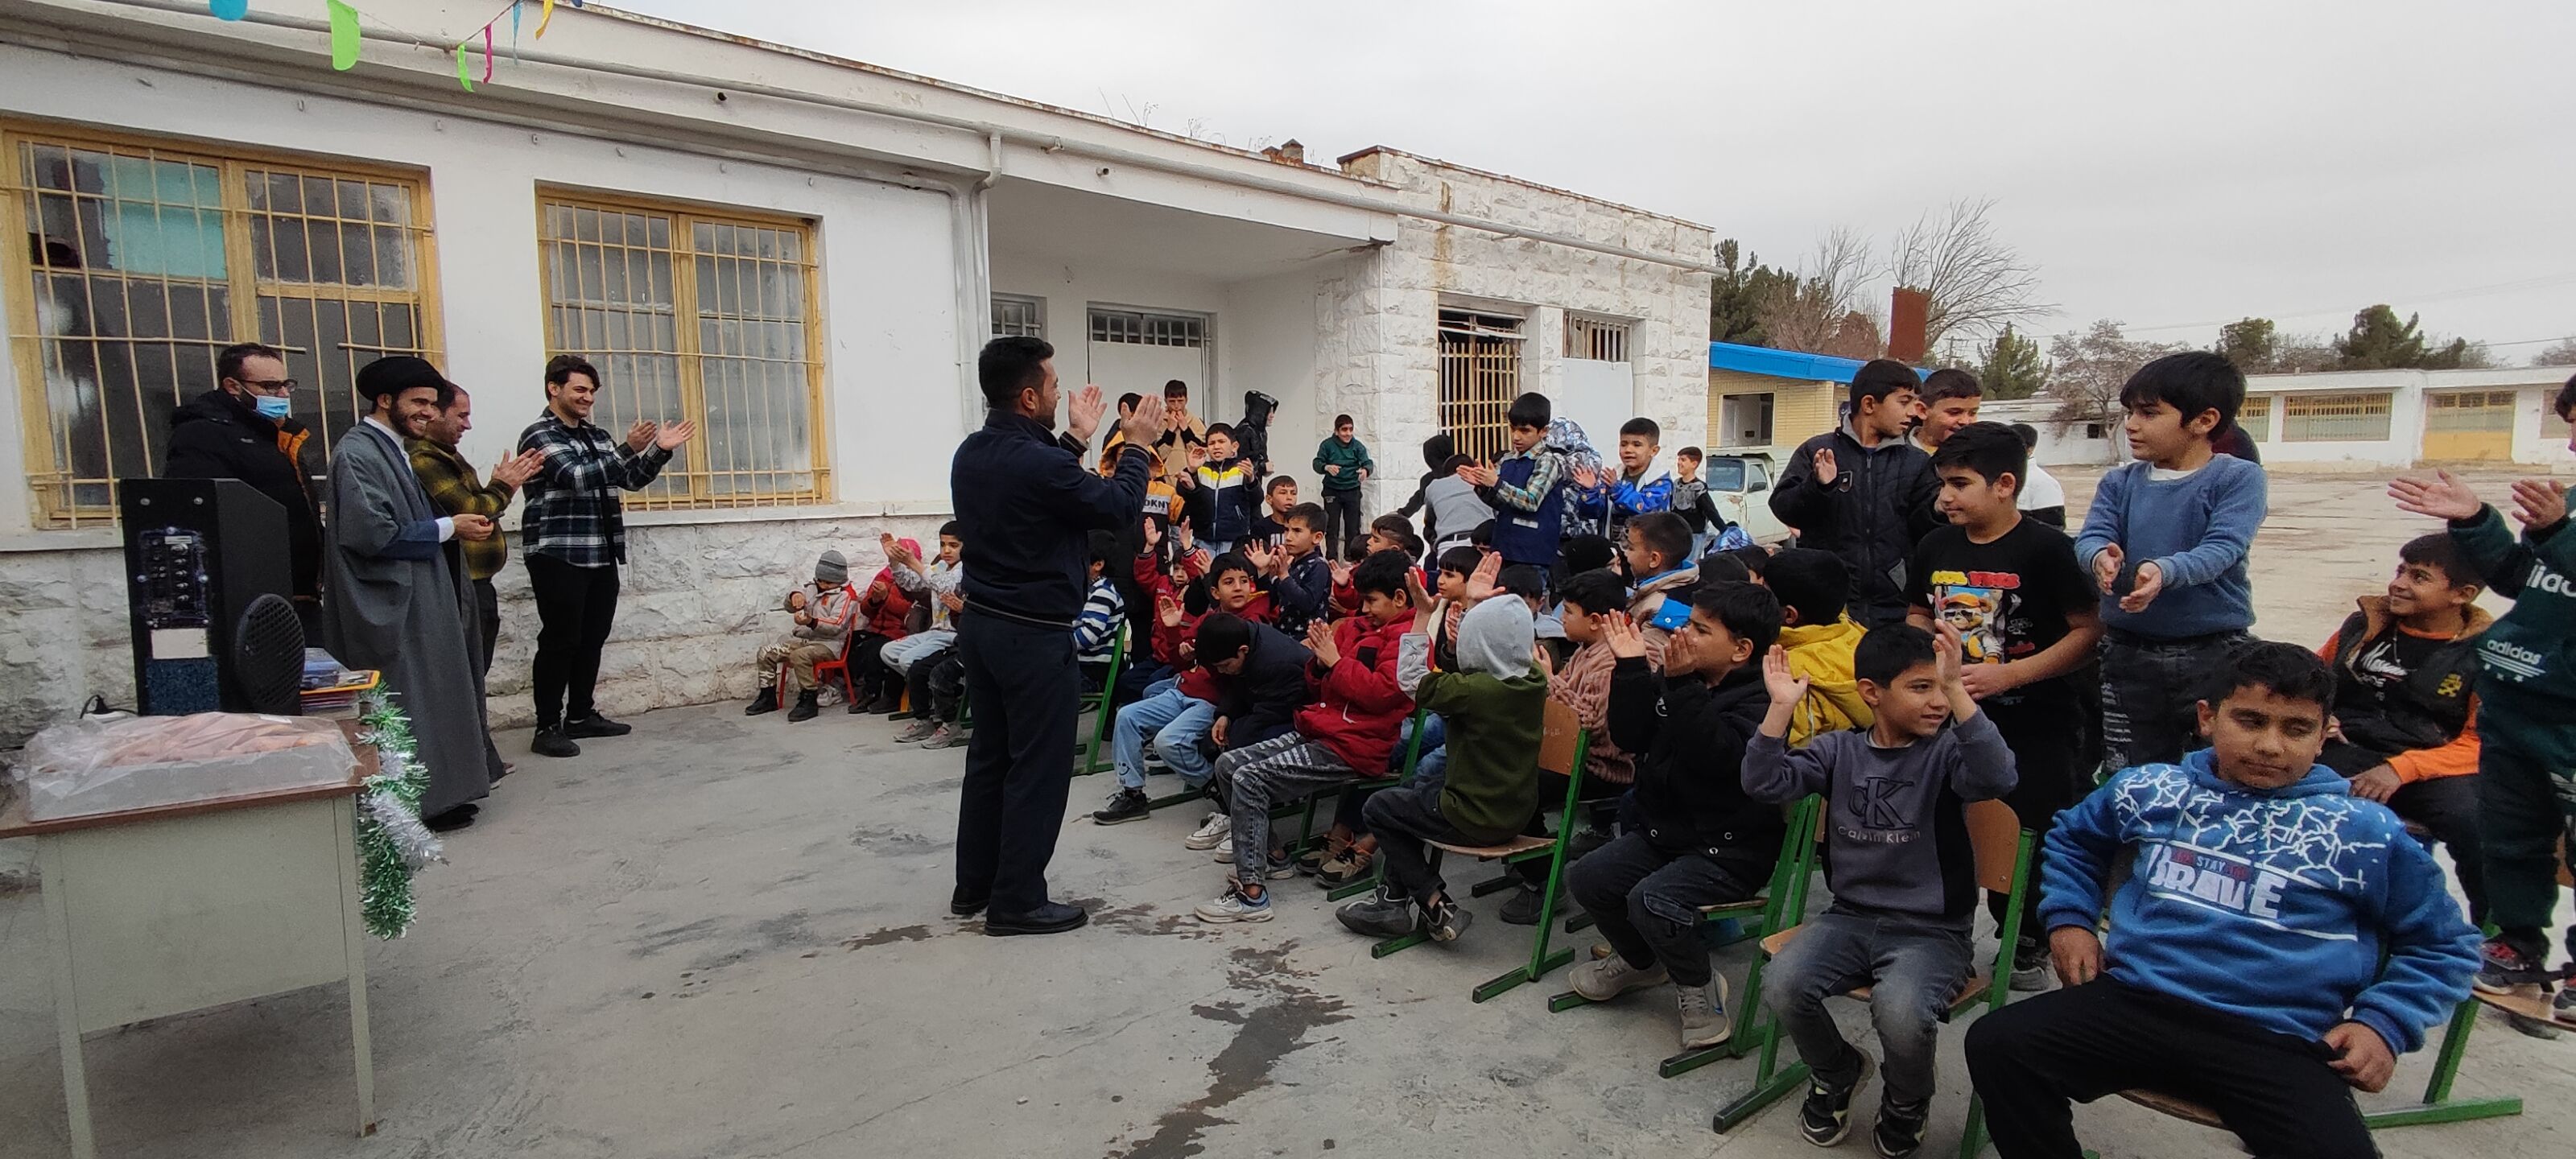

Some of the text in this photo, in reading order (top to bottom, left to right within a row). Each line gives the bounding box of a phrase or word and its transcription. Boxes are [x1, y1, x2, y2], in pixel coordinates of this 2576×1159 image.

[2487, 639, 2542, 666] adidas
[1838, 826, 1881, 843] Calvin
[2196, 855, 2227, 874] STAY
